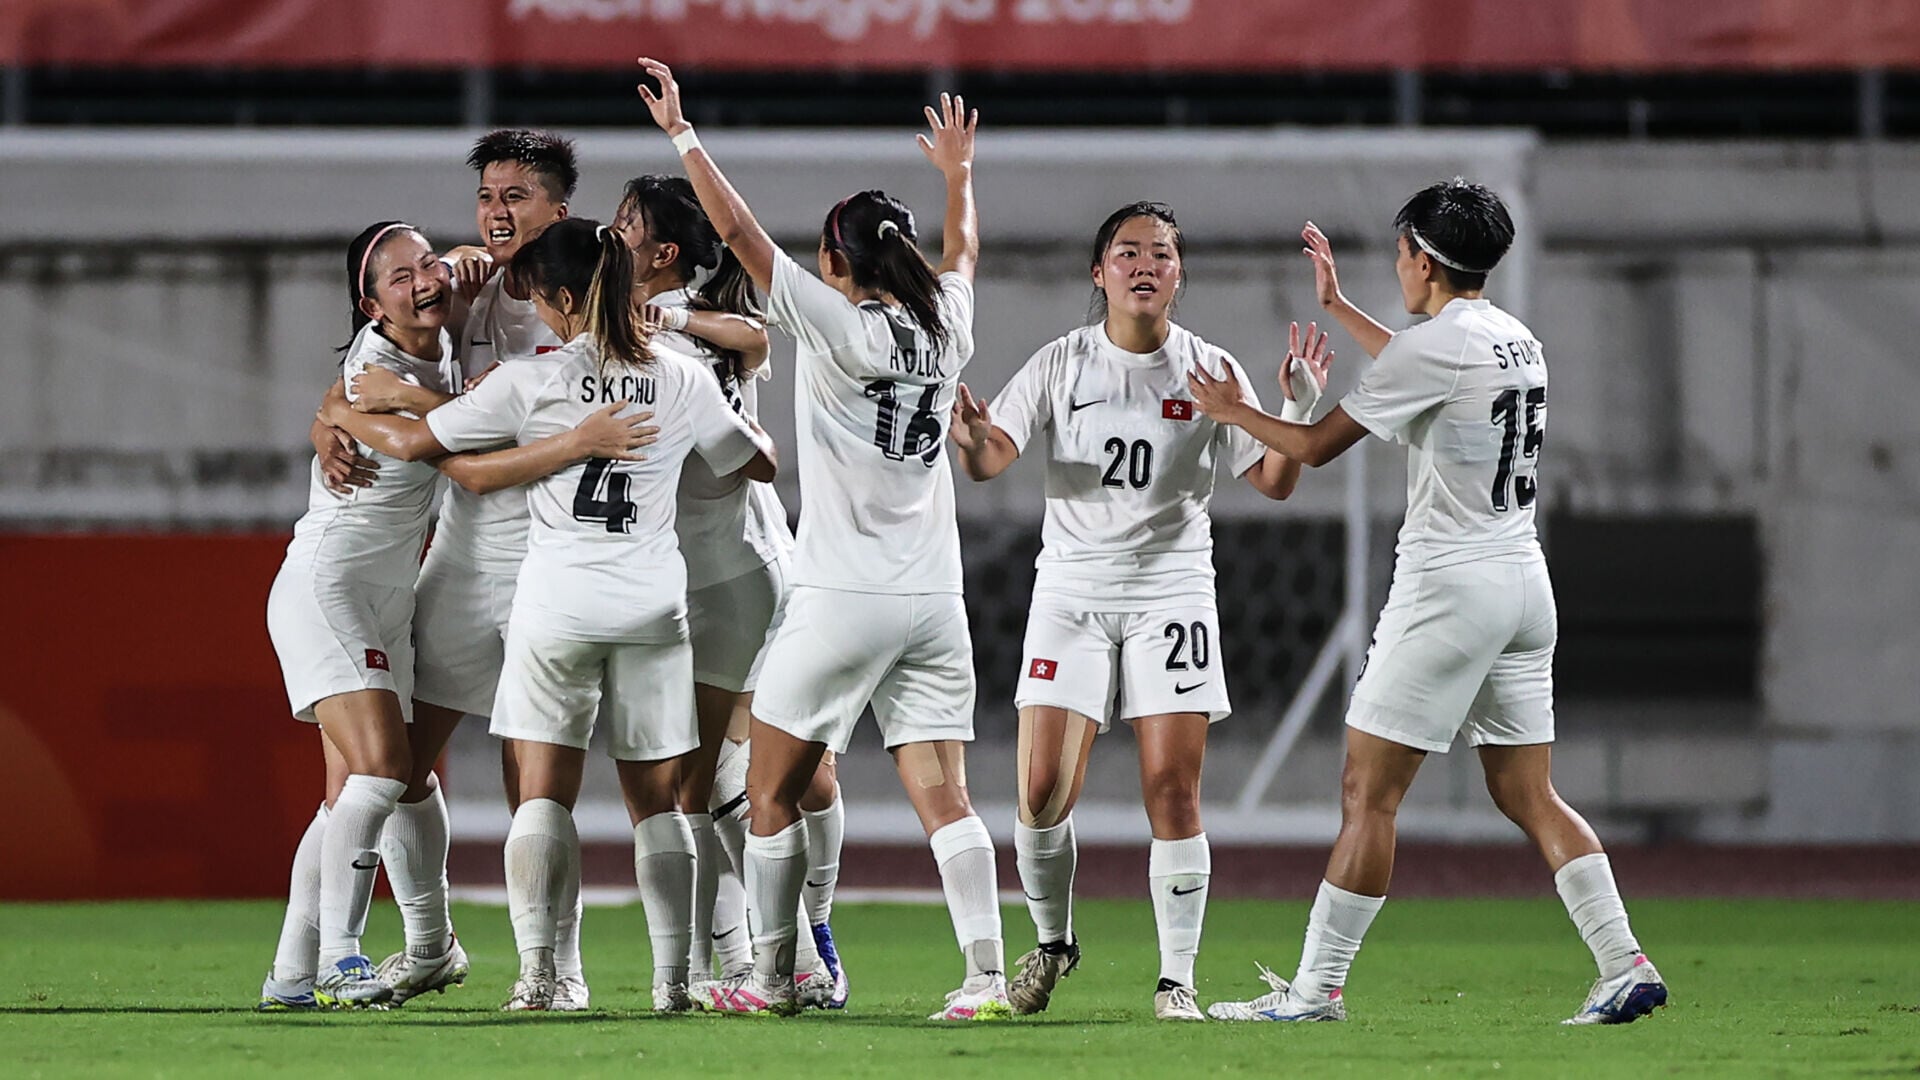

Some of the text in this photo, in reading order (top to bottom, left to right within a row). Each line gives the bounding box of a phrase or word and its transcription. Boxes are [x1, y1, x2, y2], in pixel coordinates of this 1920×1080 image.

[621, 375, 656, 405] CHU
[864, 379, 943, 468] 16
[1491, 386, 1547, 513] 15
[573, 457, 638, 535] 4
[1102, 436, 1154, 491] 20
[1164, 620, 1210, 673] 20
